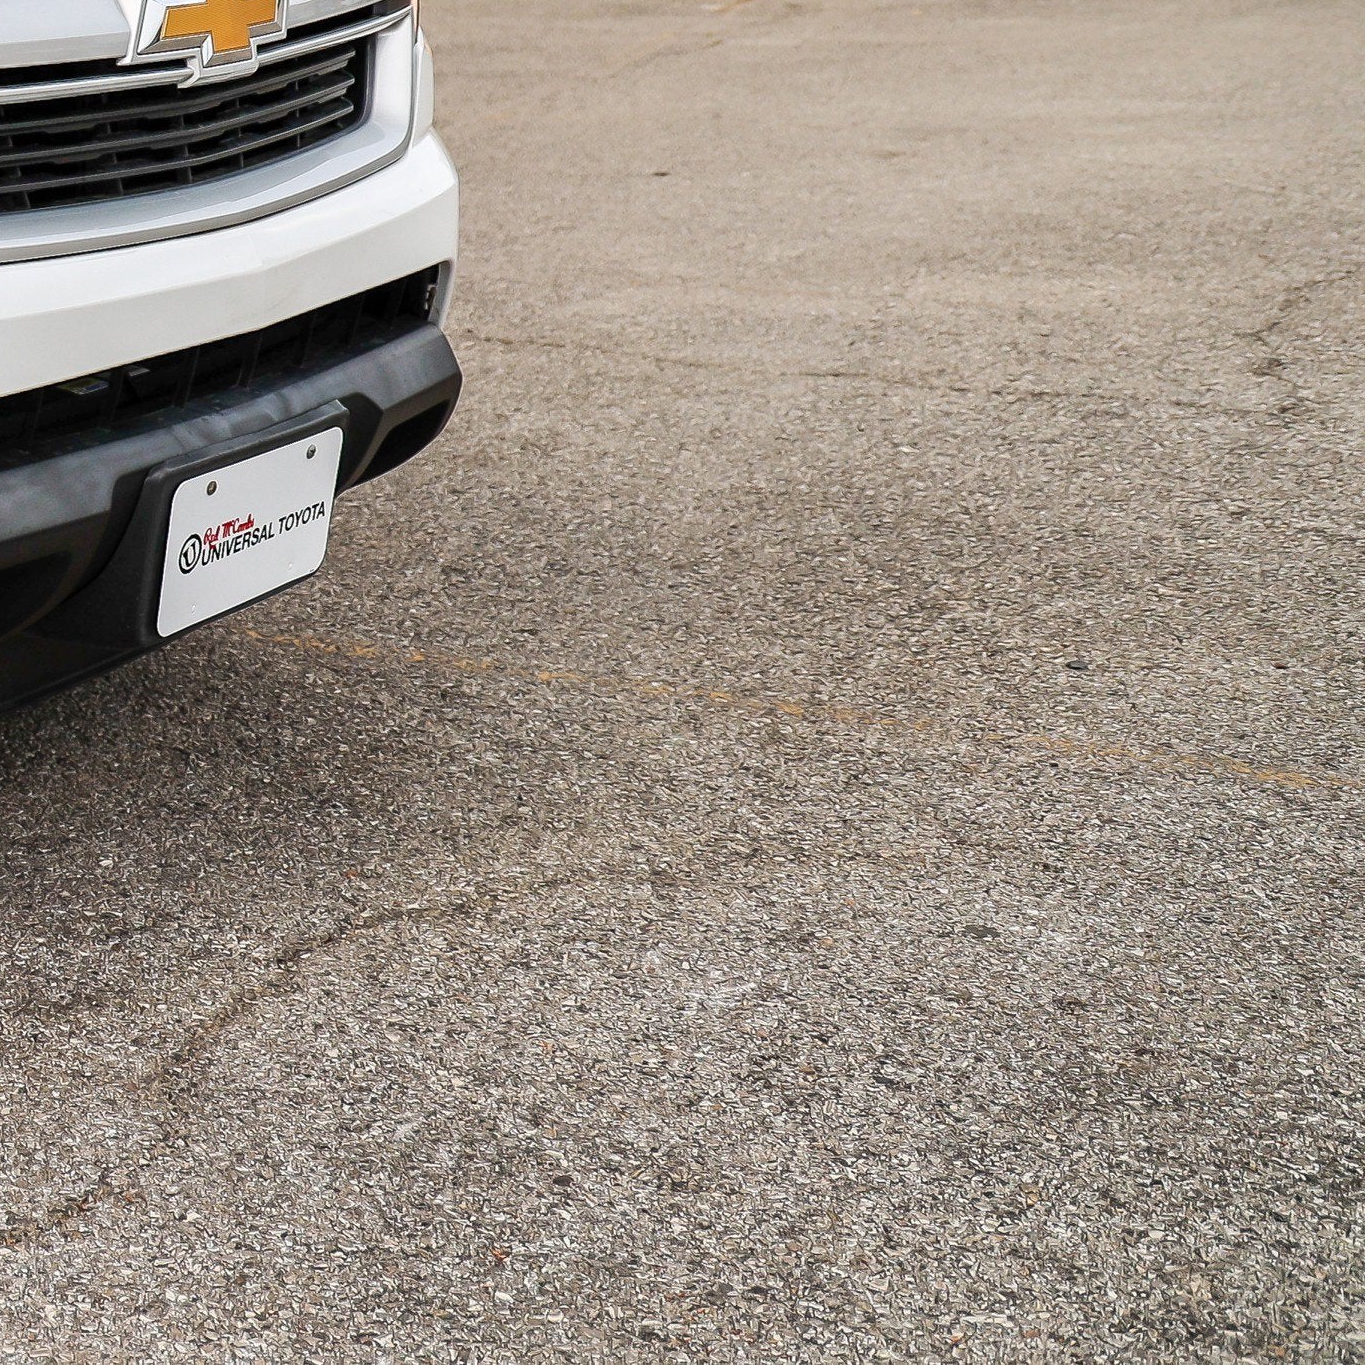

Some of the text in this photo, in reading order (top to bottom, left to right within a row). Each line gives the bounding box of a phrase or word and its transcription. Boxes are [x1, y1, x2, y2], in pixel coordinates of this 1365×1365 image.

[201, 501, 325, 567] UNIVERSAL TOYOTA
[203, 525, 220, 547] Red
